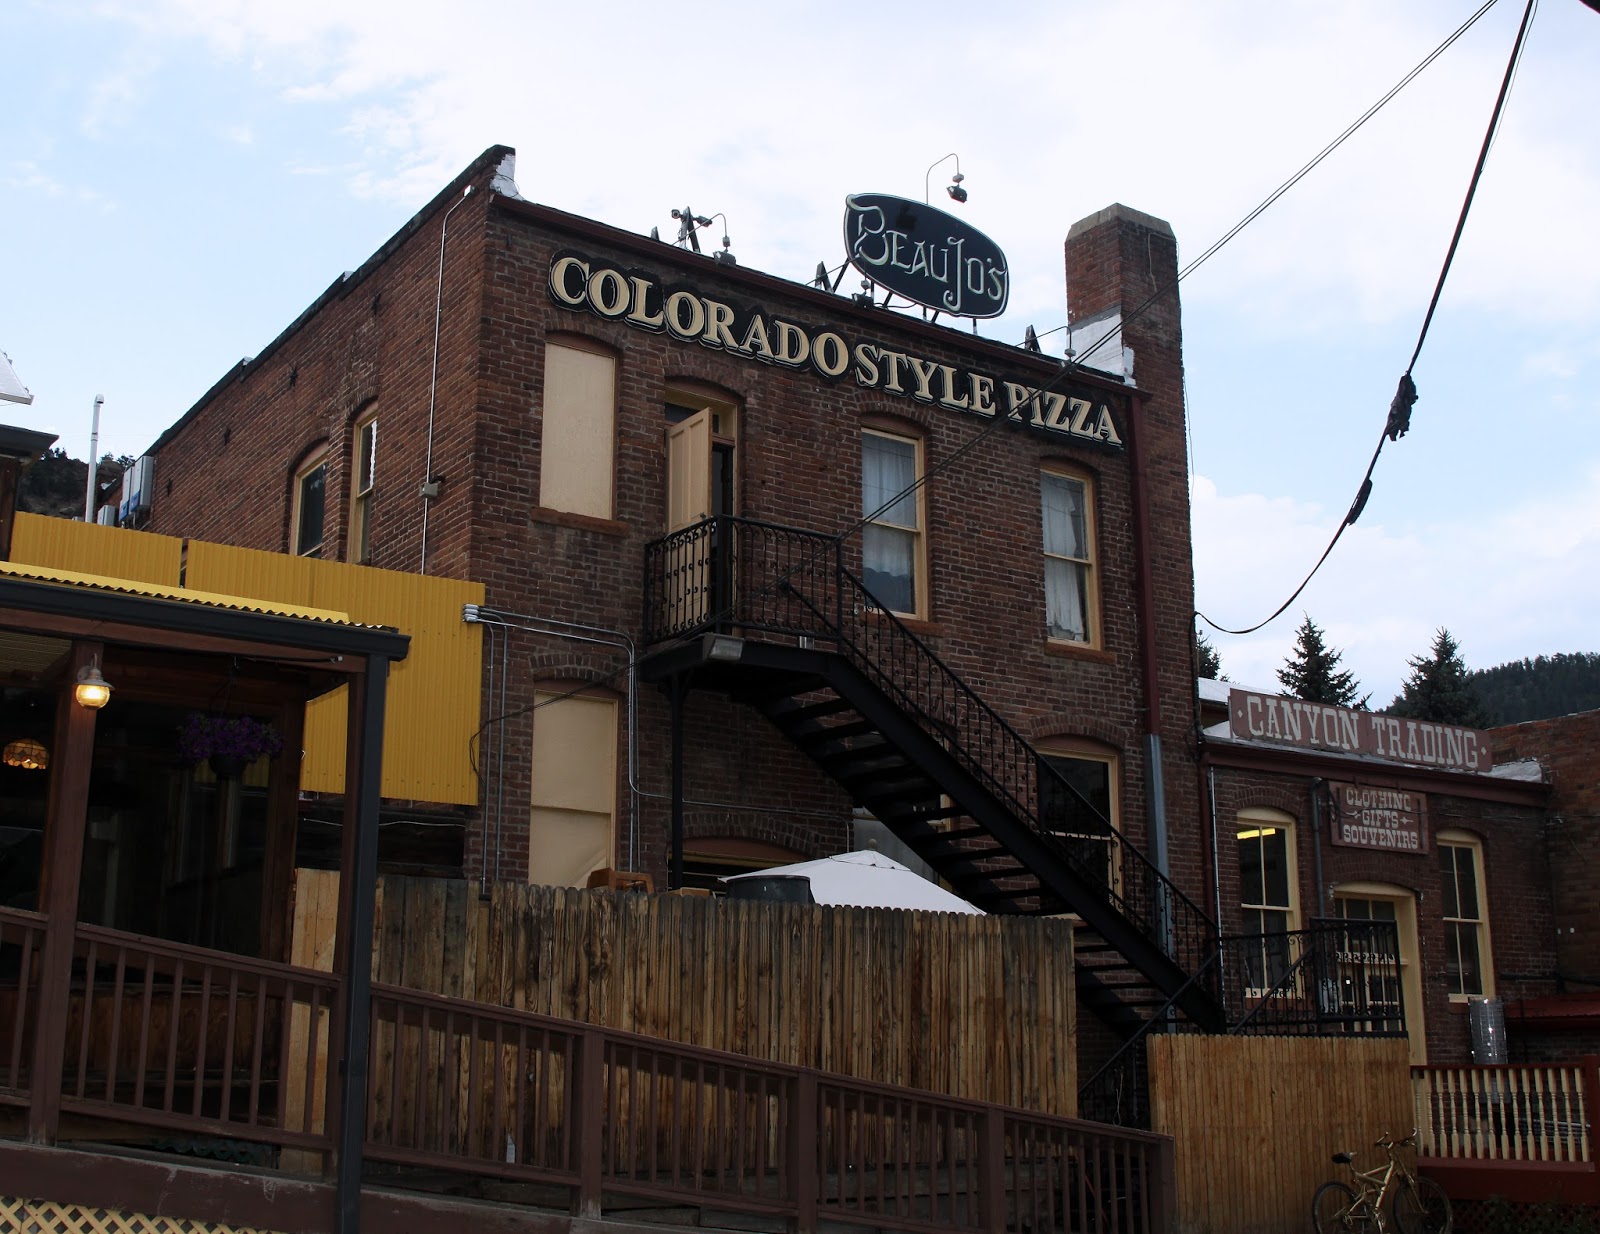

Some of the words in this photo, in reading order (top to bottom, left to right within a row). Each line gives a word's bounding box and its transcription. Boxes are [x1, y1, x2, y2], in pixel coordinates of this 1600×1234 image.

[549, 257, 849, 378] COLORADO
[855, 343, 996, 418] STYLE
[1003, 381, 1123, 446] PIZZA
[1246, 696, 1359, 749] CANYON
[1372, 716, 1478, 769] TRADING
[1343, 824, 1418, 850] SOUVENIRS
[1362, 809, 1399, 829] GIFTS
